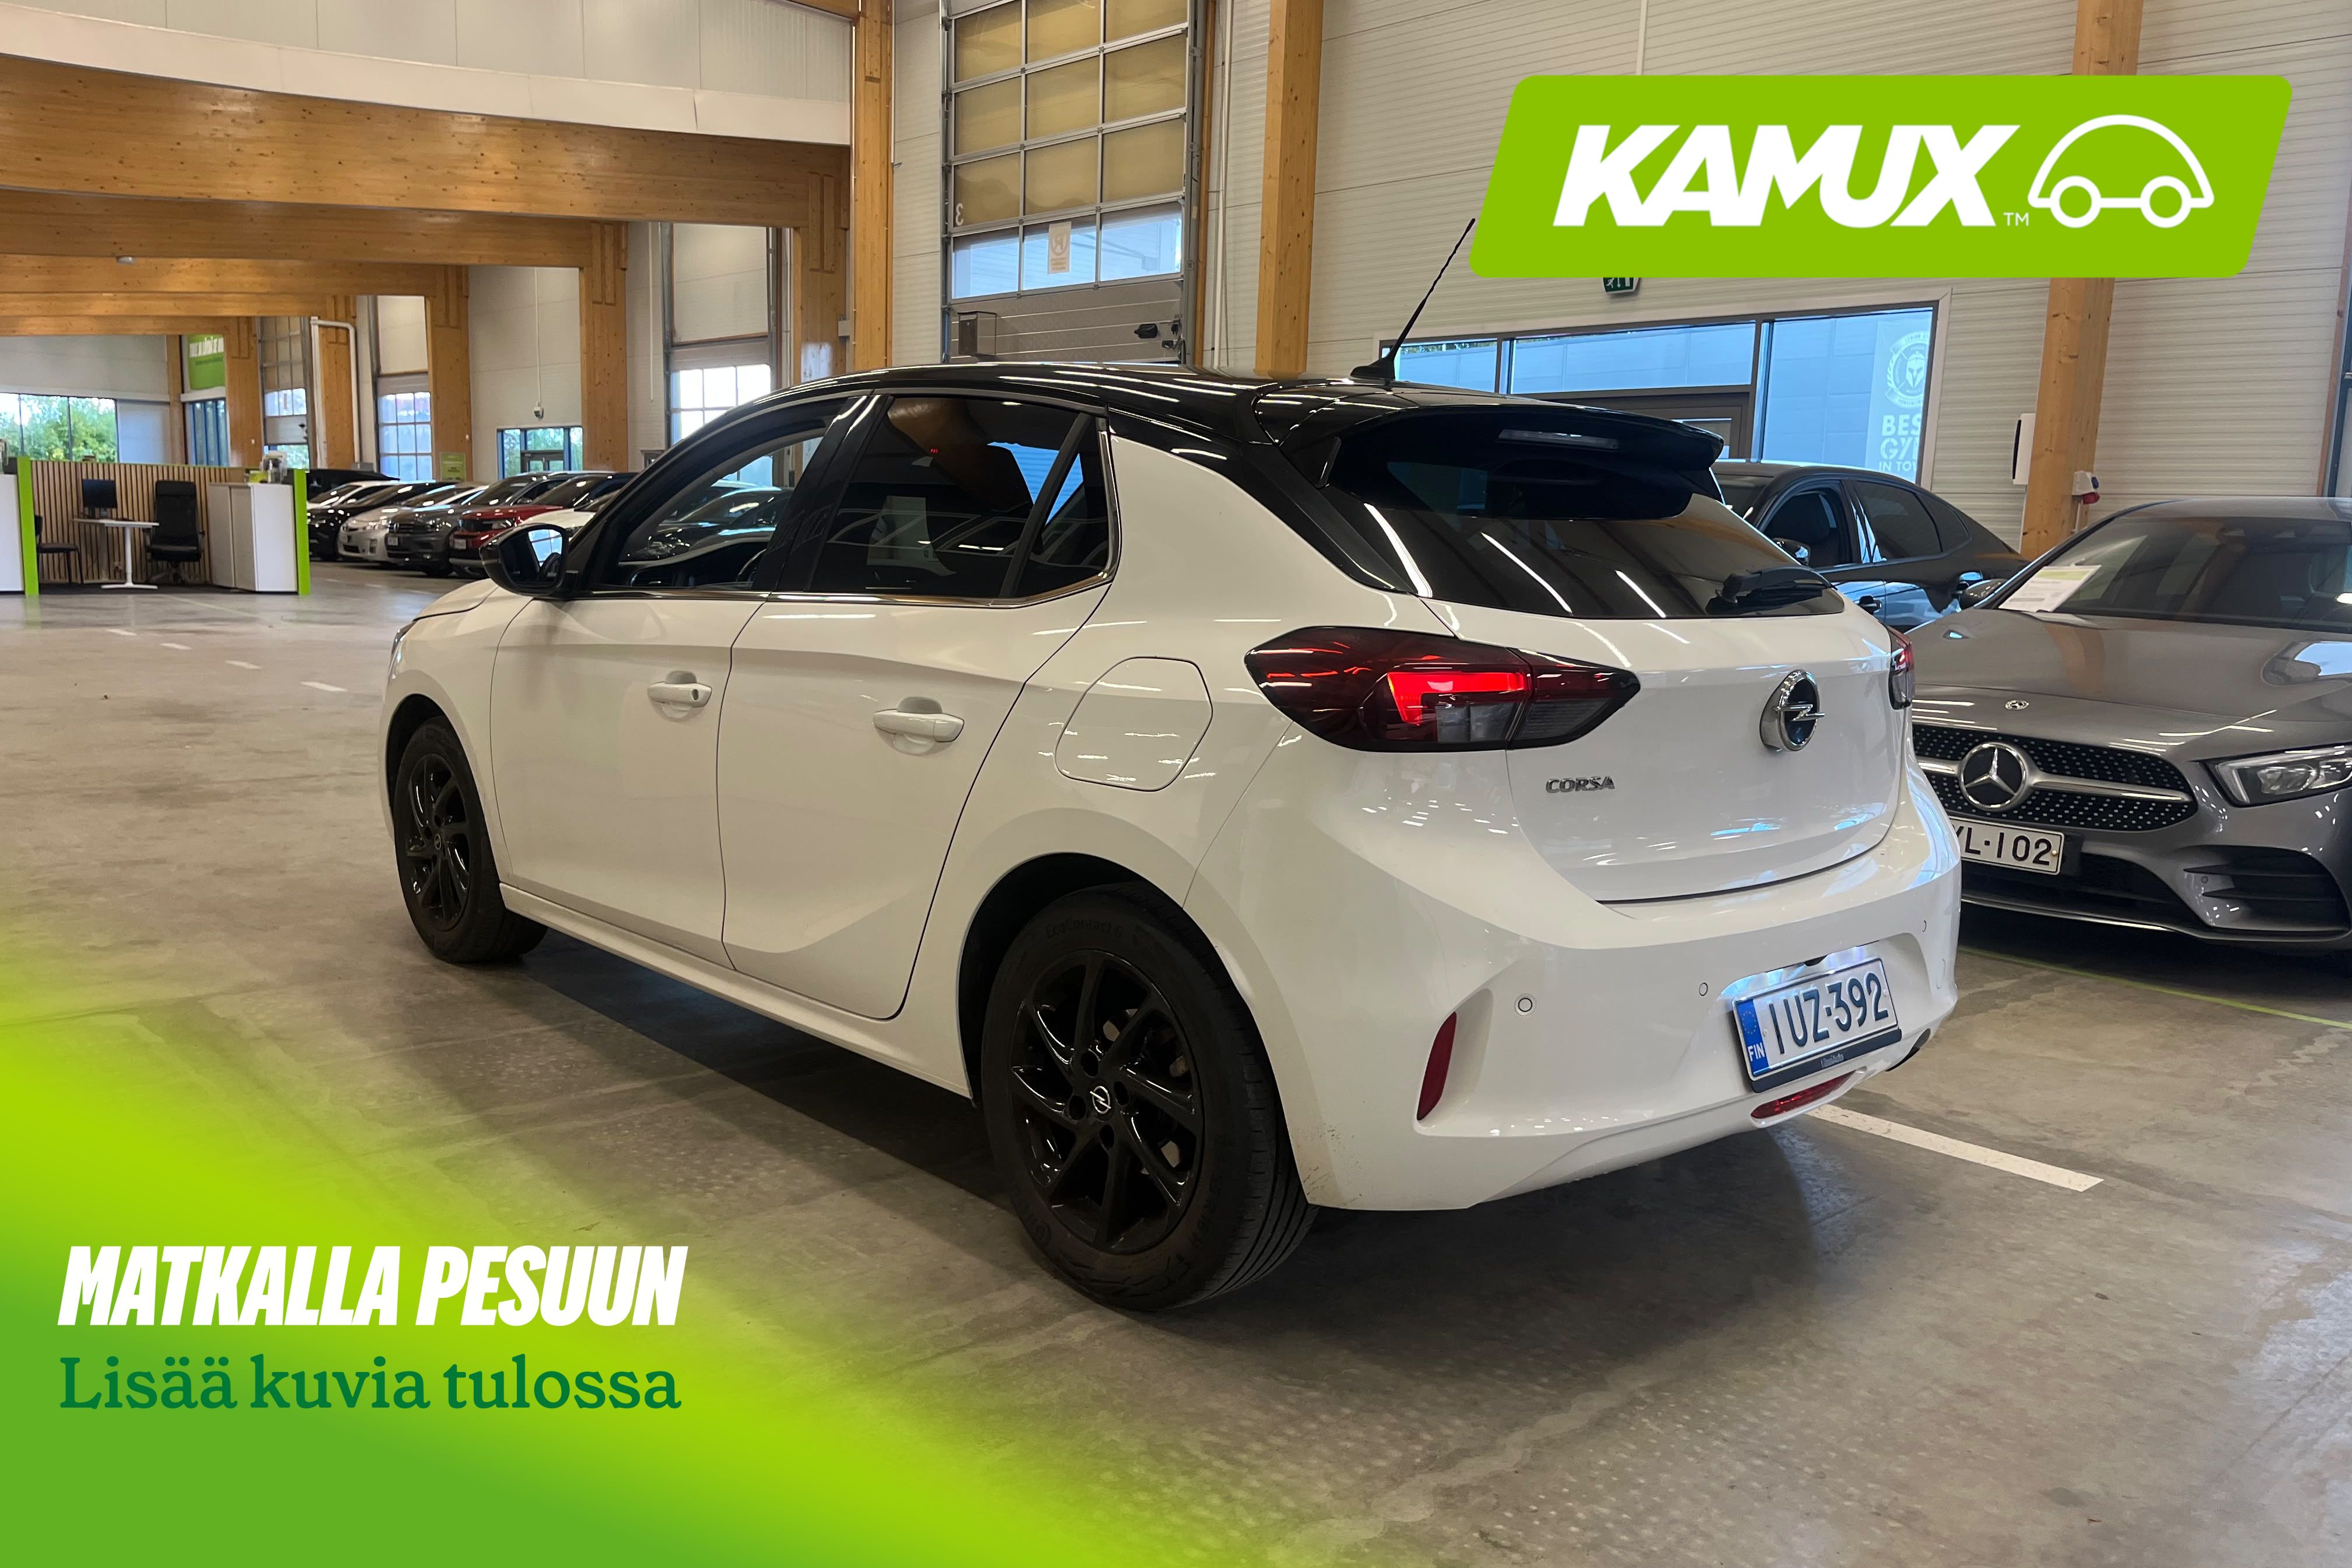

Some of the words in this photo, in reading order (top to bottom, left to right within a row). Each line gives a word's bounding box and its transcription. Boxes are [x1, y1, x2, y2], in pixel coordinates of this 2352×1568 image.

[1879, 462, 1890, 472] IN
[1546, 775, 1615, 793] CORSA
[1768, 972, 1889, 1054] IUZ-392
[1747, 1042, 1765, 1062] FIN
